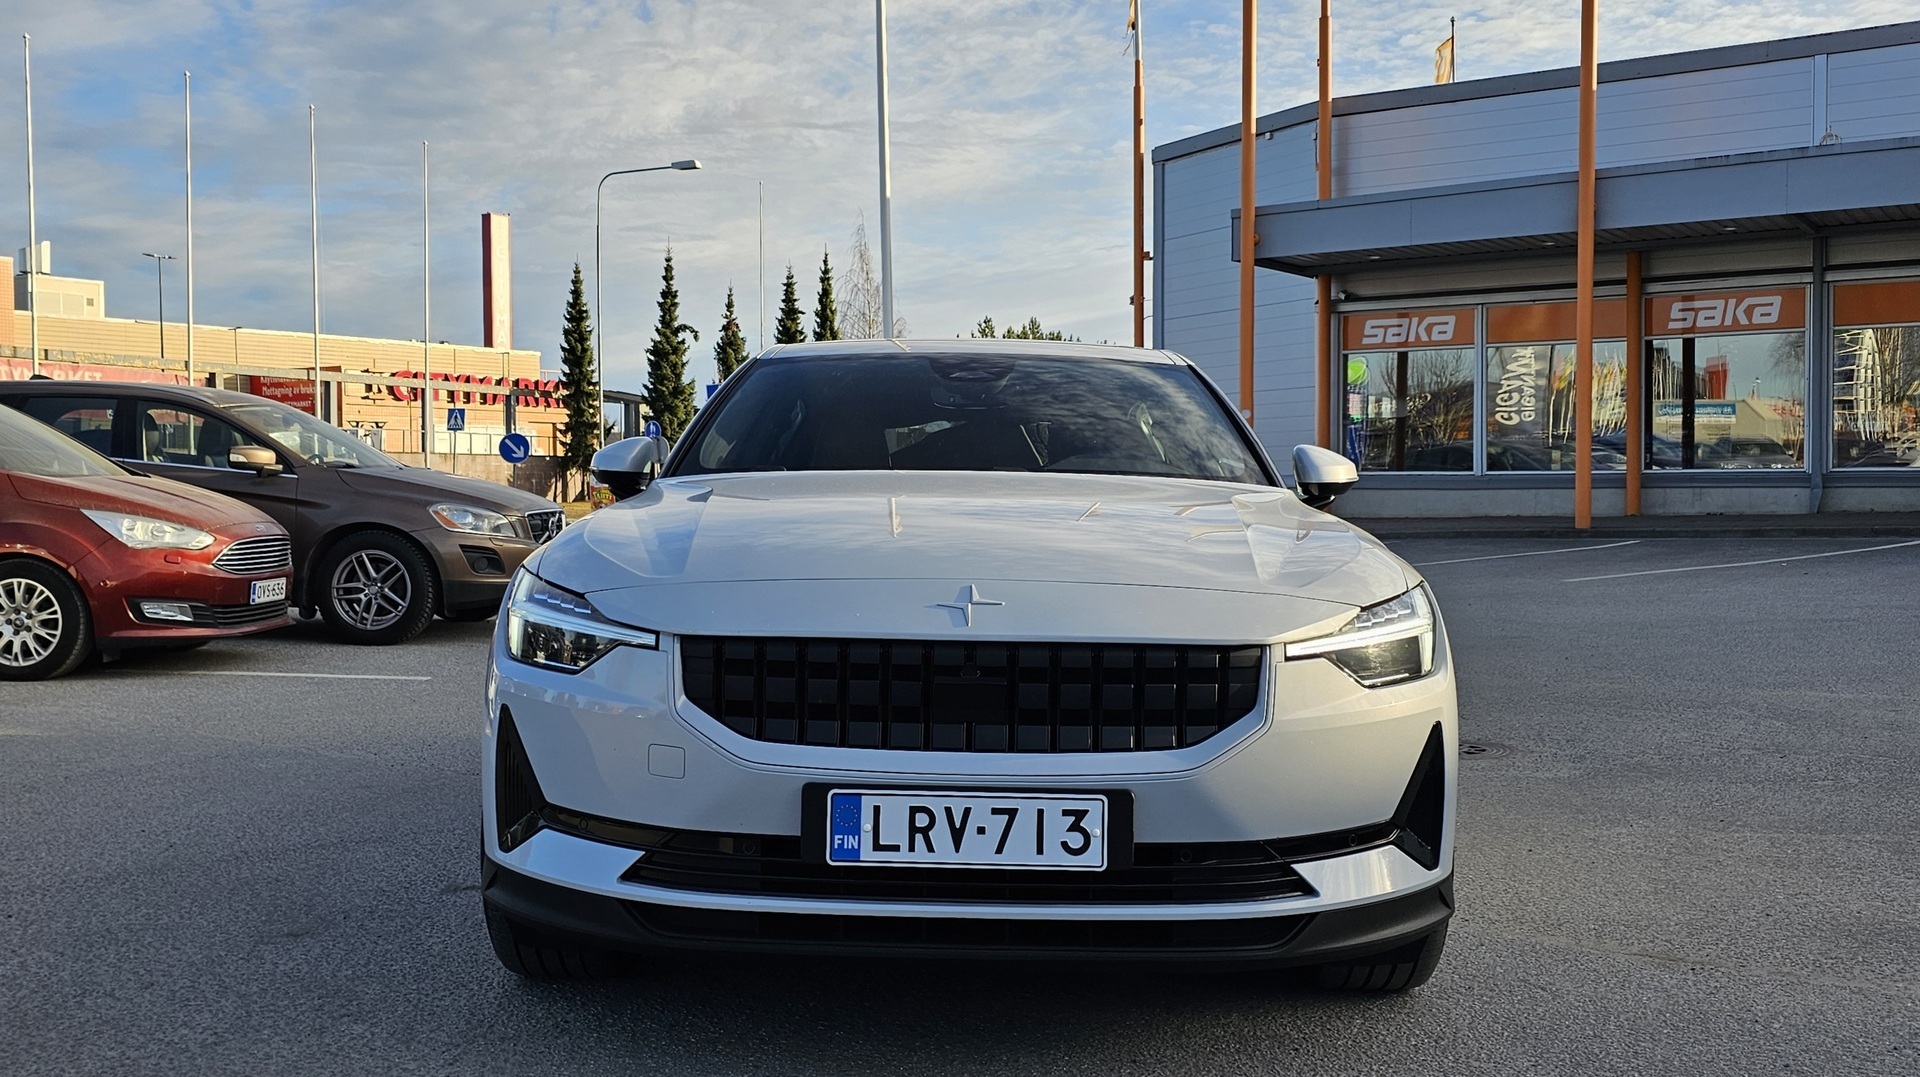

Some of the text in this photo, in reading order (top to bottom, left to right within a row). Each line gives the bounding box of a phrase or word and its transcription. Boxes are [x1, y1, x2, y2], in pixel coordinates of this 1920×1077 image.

[262, 385, 293, 397] Mottagning
[394, 370, 565, 408] CITYMARK
[834, 803, 1092, 857] FIN LRV-713
